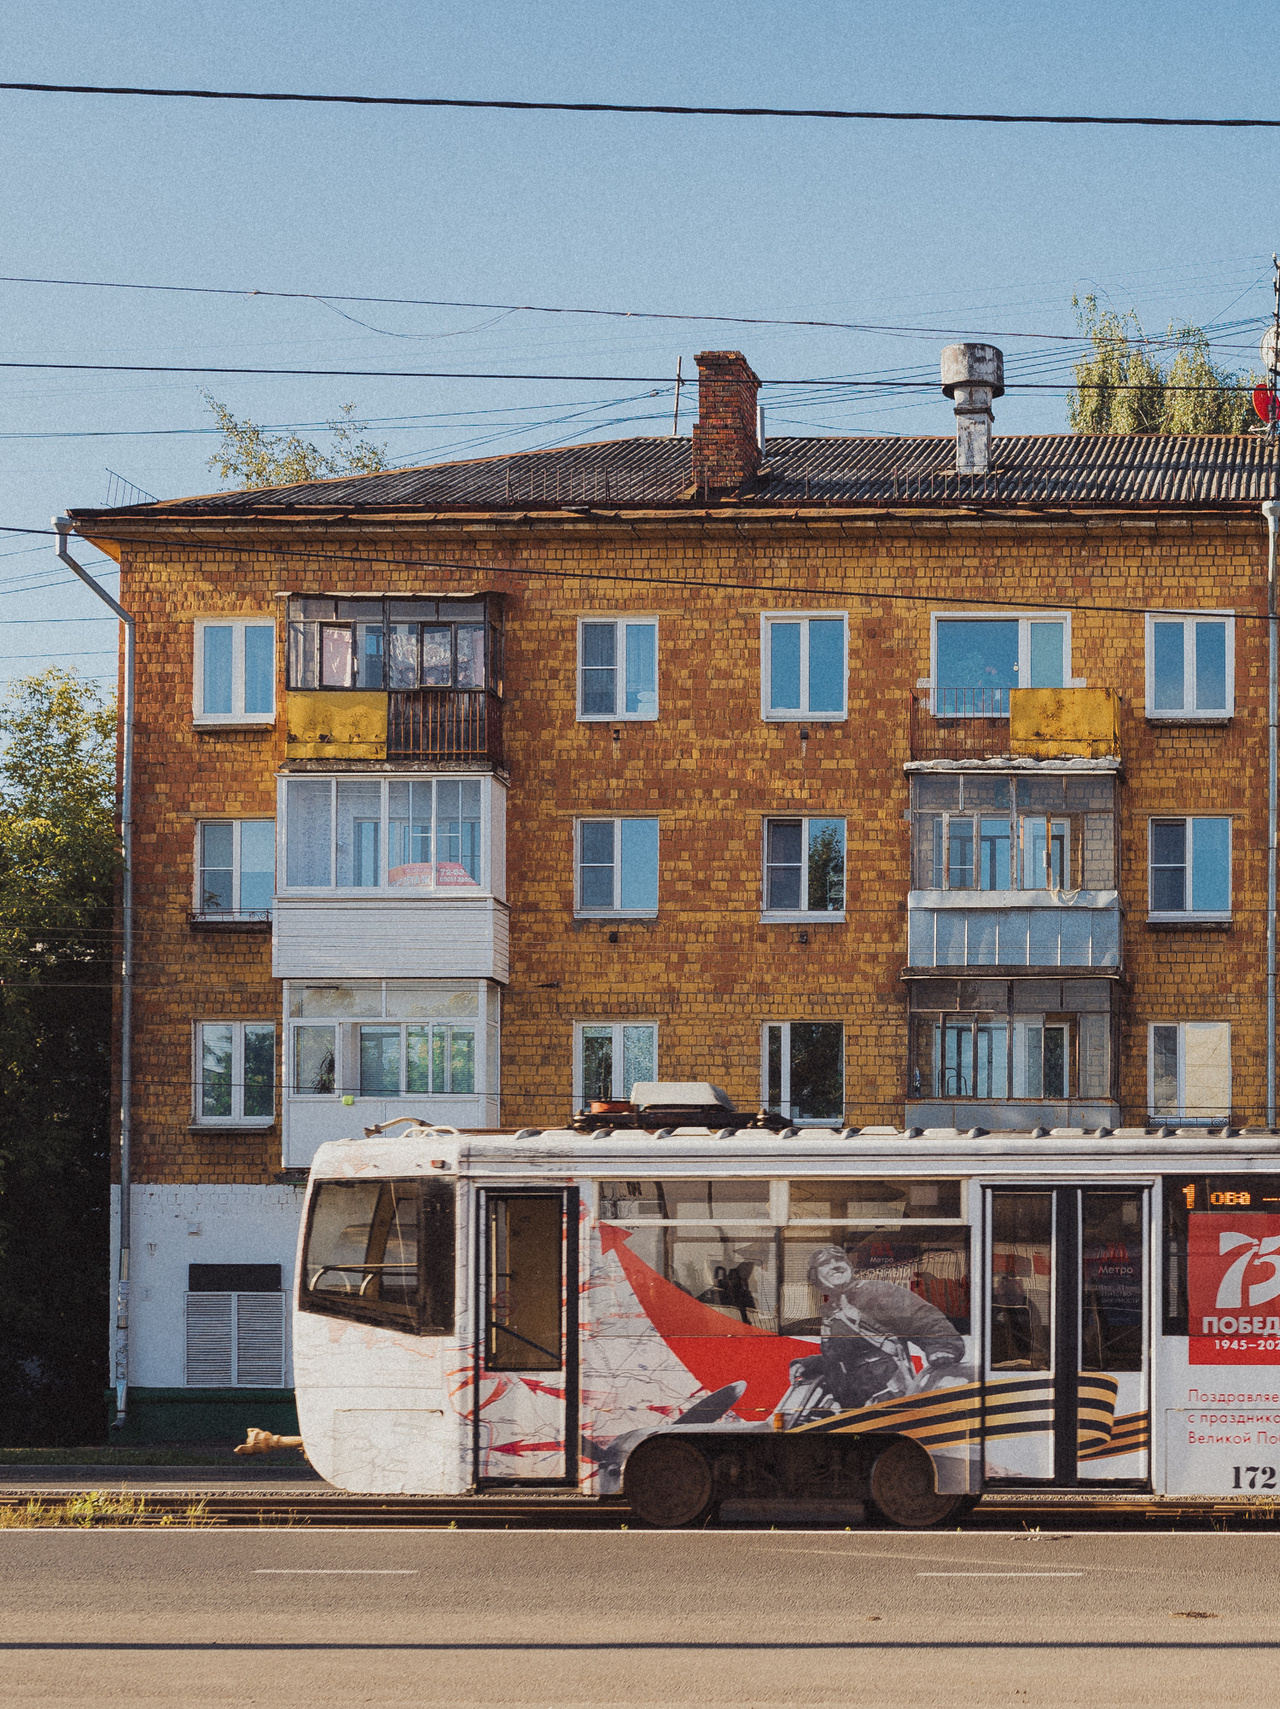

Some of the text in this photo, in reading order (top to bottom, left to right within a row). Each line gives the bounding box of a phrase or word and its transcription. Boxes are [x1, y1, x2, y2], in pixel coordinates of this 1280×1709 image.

[1182, 1183, 1195, 1209] 1
[1210, 1191, 1251, 1206] ова
[1097, 1265, 1134, 1276] Метро
[1188, 1414, 1196, 1424] с
[1188, 1430, 1251, 1445] Великой
[1231, 1465, 1278, 1490] 172
